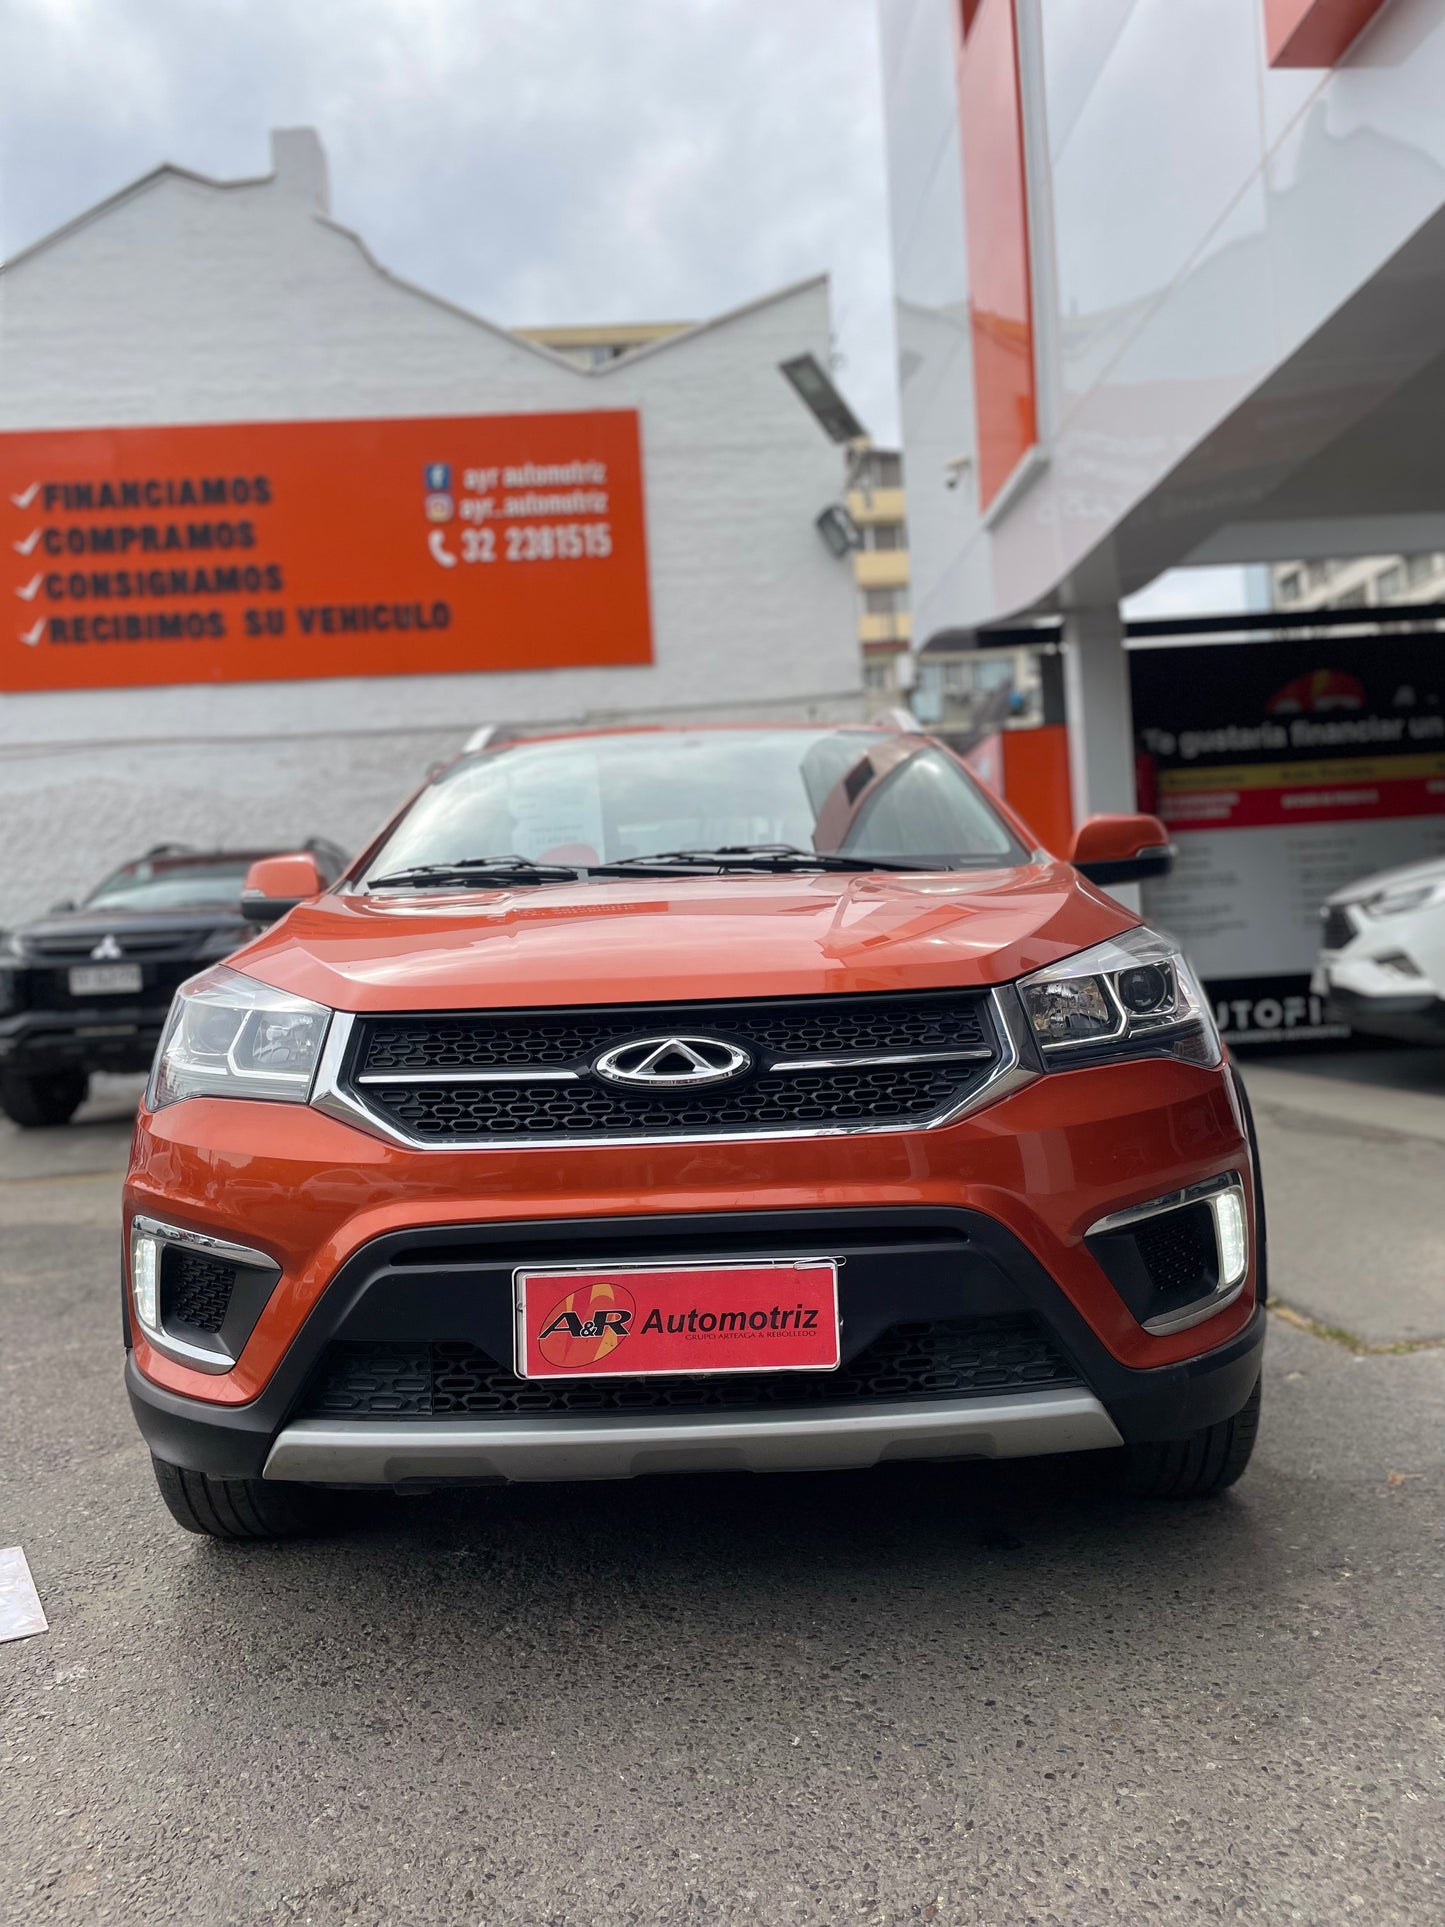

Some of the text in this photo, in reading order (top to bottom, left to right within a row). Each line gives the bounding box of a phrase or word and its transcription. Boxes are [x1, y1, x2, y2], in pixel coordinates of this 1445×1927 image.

[502, 459, 606, 488] automotriz
[43, 476, 273, 512] FINANCIAMOS
[44, 521, 257, 556] COMPRAMOS
[461, 527, 496, 563] 32
[44, 565, 283, 601] CONSIGNAMOS
[49, 602, 451, 645] RECIBIMOS SU VEHICULO
[641, 1303, 818, 1334] Automotriz
[685, 1332, 717, 1341] GRUPO
[718, 1332, 756, 1340] ARTEAGA
[766, 1330, 817, 1338] REBOLLEDO
